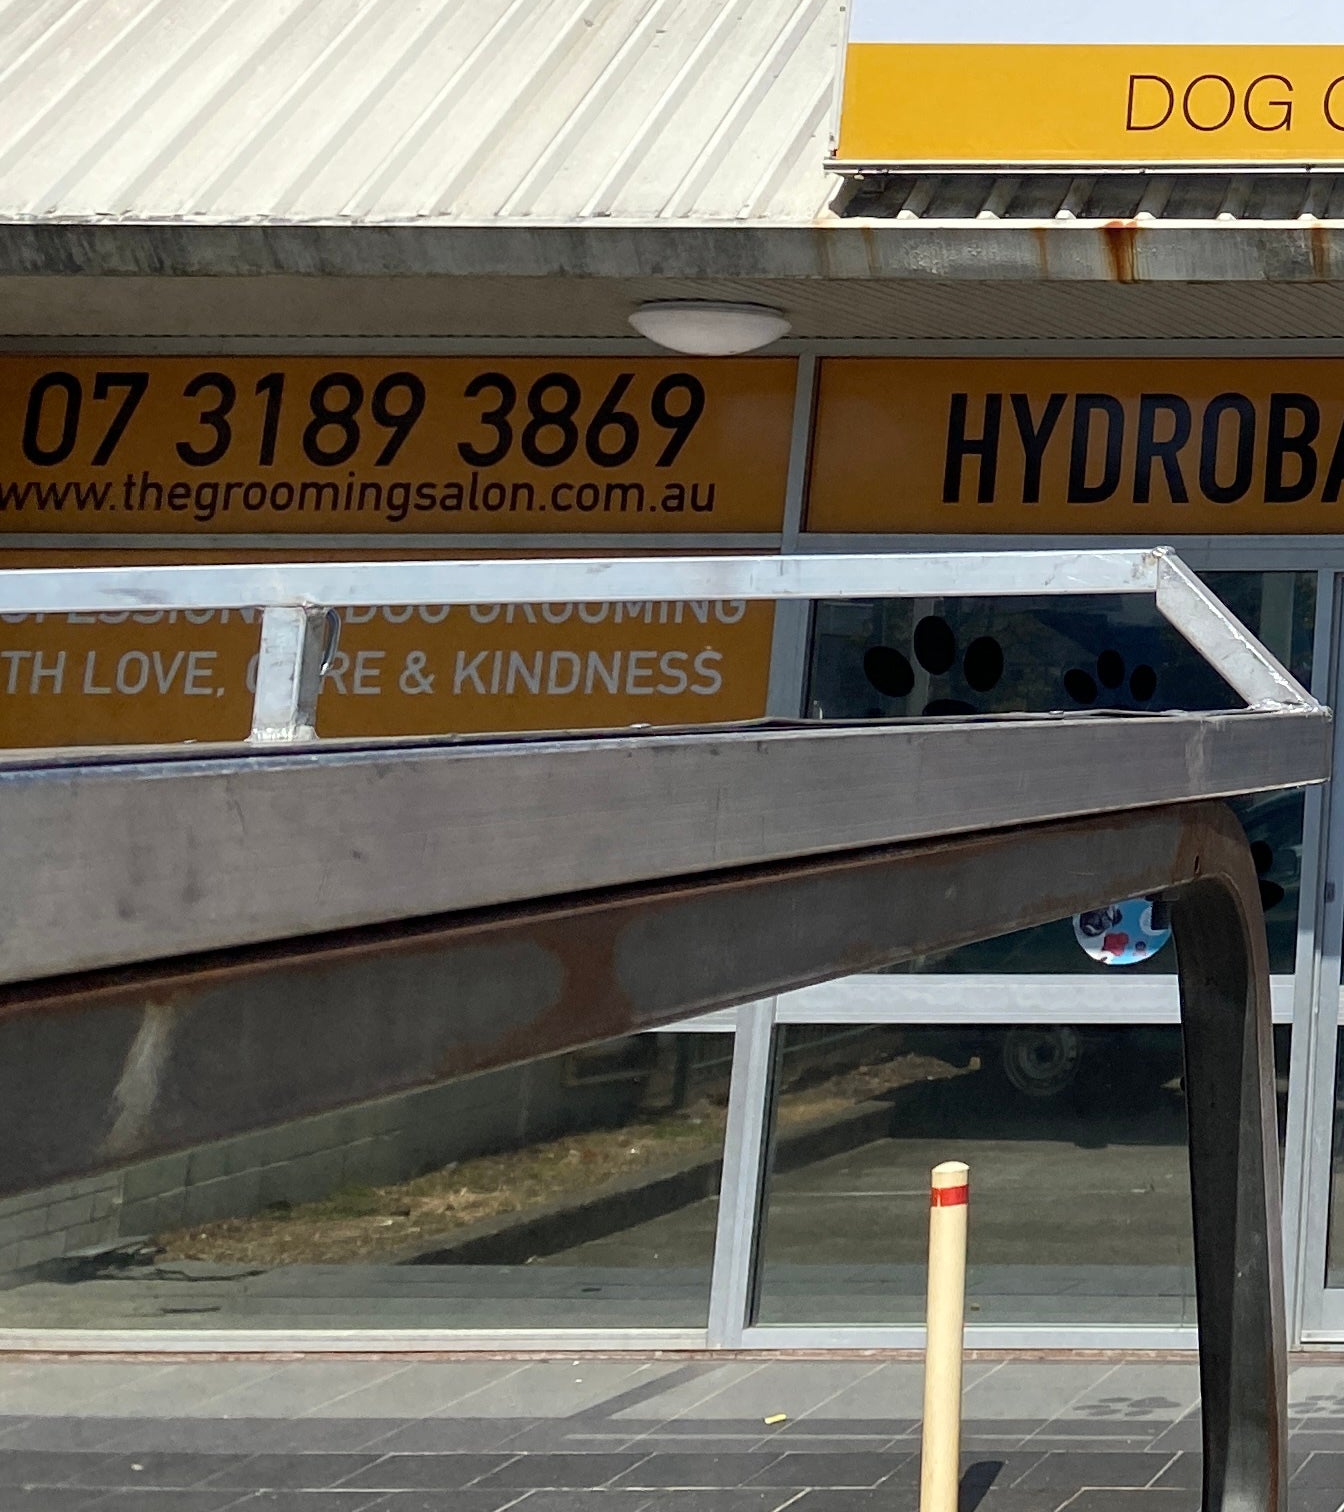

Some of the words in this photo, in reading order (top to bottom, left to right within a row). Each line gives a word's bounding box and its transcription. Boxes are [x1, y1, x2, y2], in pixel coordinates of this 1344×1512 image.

[1125, 73, 1293, 133] DOG
[22, 371, 149, 468] 07
[175, 371, 426, 469] 3189
[457, 371, 706, 469] 3869
[0, 472, 716, 522] www.thegroomingsalon.com.au
[82, 650, 225, 698] LOVE,
[399, 650, 436, 695] &
[453, 649, 724, 696] KINDNESS
